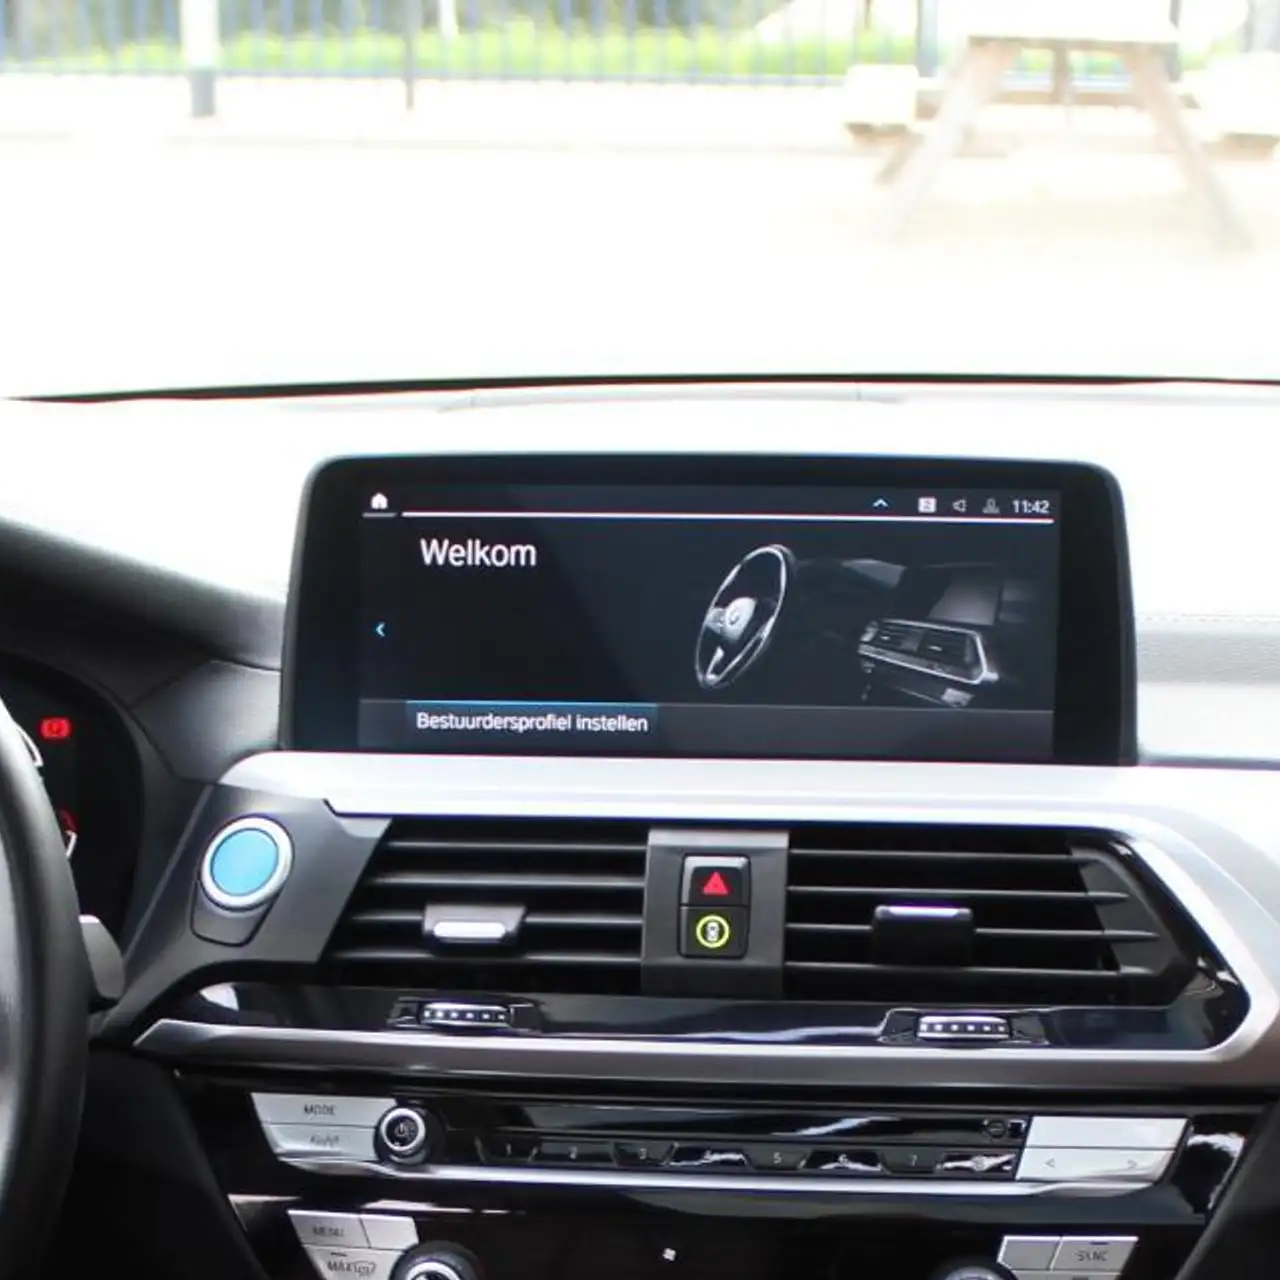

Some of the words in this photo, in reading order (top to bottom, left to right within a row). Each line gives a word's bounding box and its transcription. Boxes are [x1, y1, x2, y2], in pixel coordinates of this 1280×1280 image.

[1013, 499, 1050, 514] 11:42
[420, 538, 536, 567] Welkom
[416, 711, 571, 733] Bestuurdersprofiel
[576, 714, 648, 732] instellen
[303, 1103, 337, 1115] MODE
[773, 1151, 782, 1164] 5
[327, 1260, 352, 1272] MAX
